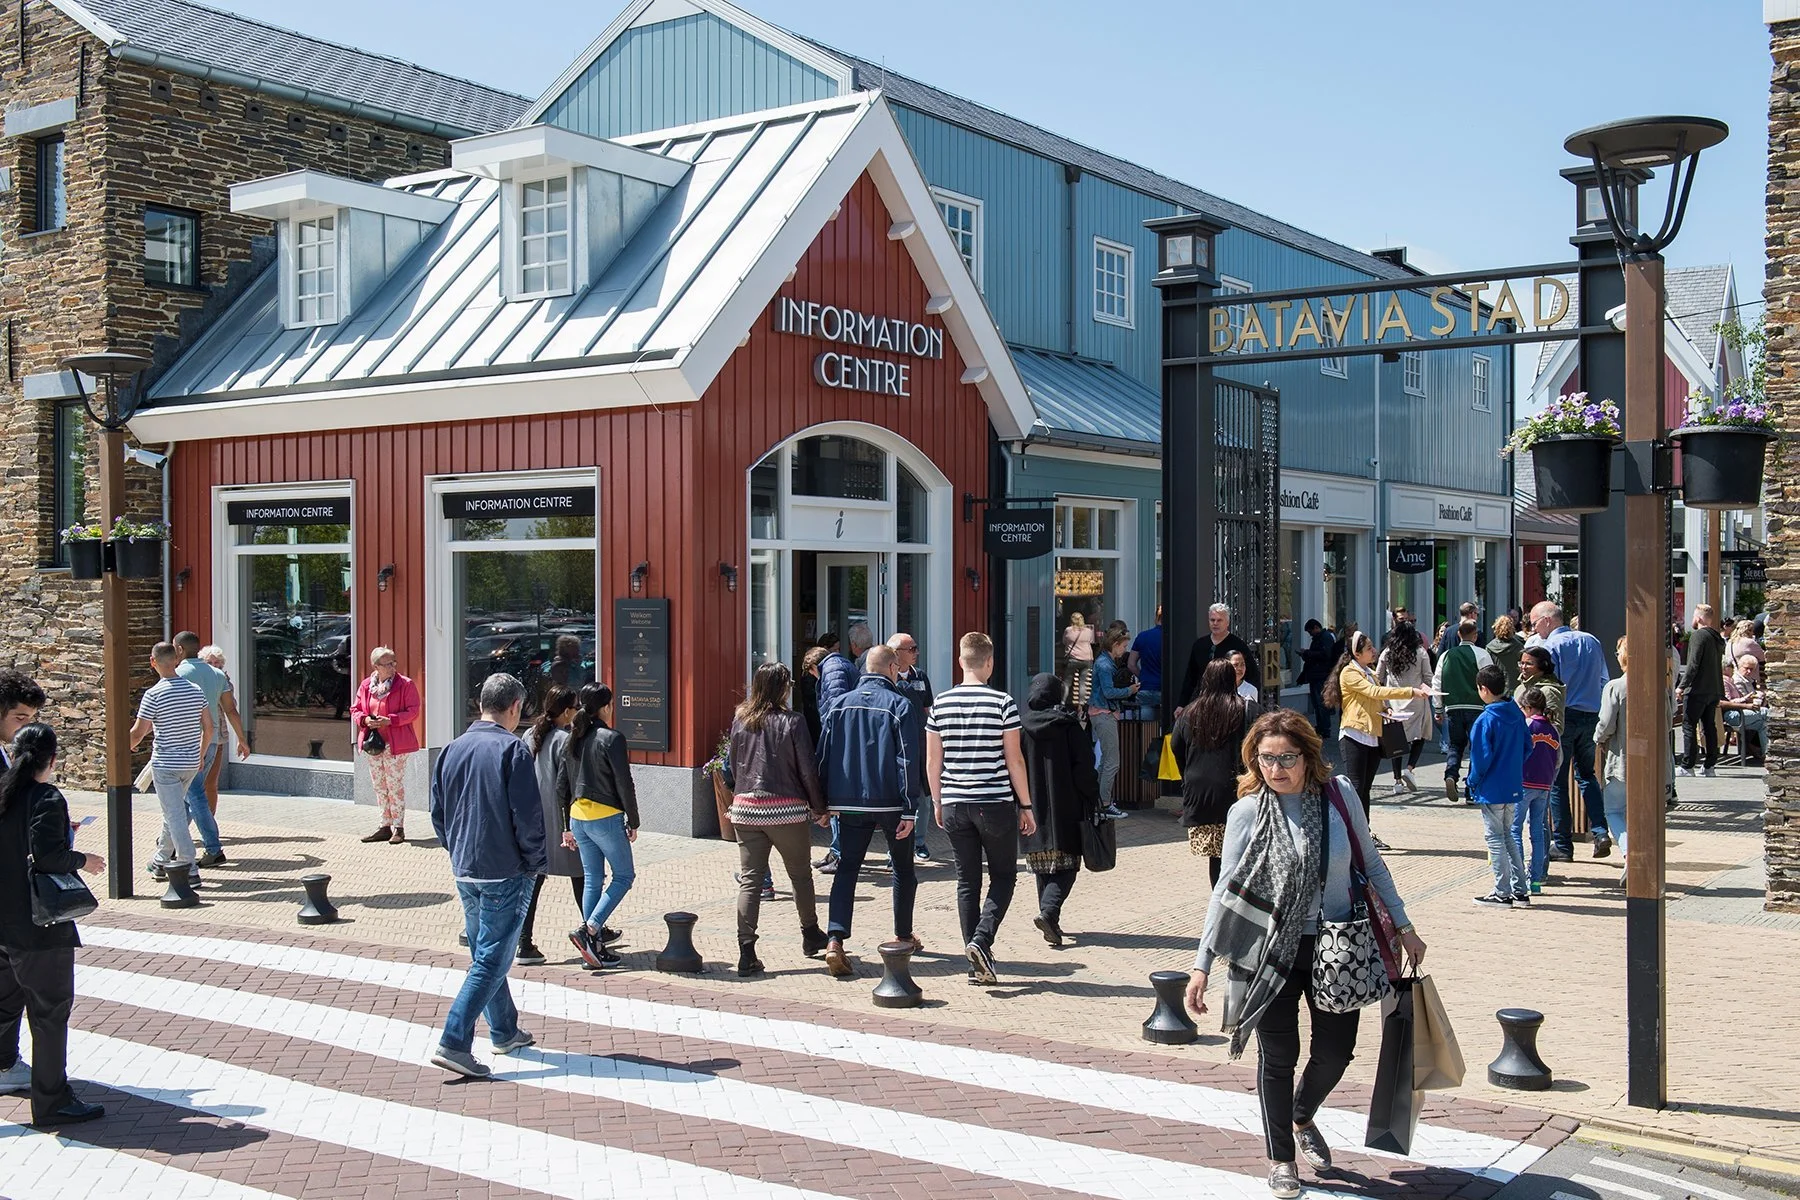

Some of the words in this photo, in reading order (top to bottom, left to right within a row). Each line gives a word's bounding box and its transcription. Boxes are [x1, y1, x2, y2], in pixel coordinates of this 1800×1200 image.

[1209, 289, 1412, 352] BATAVIA
[1430, 277, 1570, 337] STAD
[780, 296, 943, 360] INFORMATION
[820, 352, 911, 397] CENTRE
[465, 498, 531, 511] INFORMATION
[533, 496, 573, 508] CENTRE
[1301, 491, 1319, 510] Café
[246, 507, 299, 519] INFORMATION
[301, 506, 333, 517] CENTRE
[1439, 504, 1459, 520] Fashion
[1460, 506, 1472, 521] Café
[989, 522, 1045, 532] INFORMATION
[1000, 533, 1032, 543] CENTRE
[1395, 548, 1426, 563] Ame
